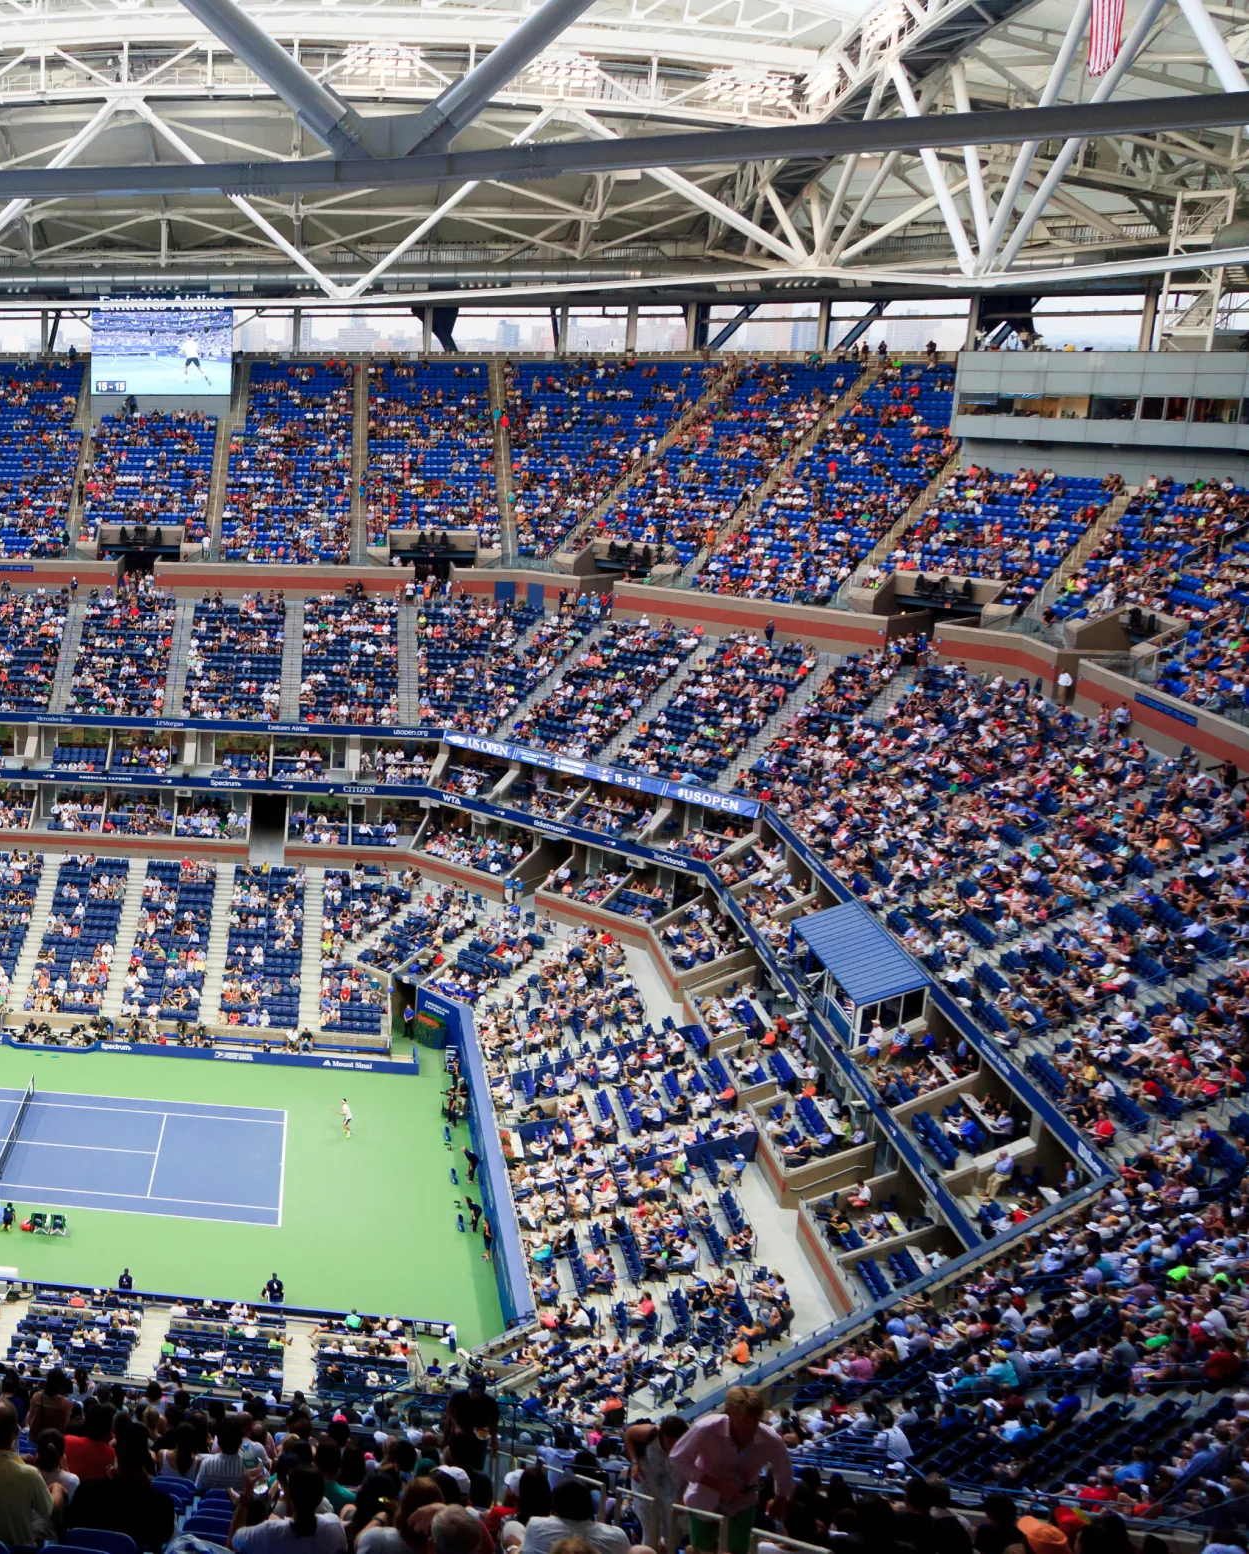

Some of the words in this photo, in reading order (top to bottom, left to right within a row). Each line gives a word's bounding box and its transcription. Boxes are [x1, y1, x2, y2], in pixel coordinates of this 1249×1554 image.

[97, 382, 107, 391] 15
[115, 382, 125, 391] 15
[36, 715, 72, 723] Mercedes-Benz
[393, 729, 429, 737] usopen.org
[467, 738, 480, 750] US
[481, 741, 509, 756] OPEN
[210, 780, 240, 788] Spectrum
[614, 773, 623, 783] 15
[628, 775, 636, 786] 15
[343, 785, 376, 794] CITIZEN
[442, 793, 461, 805] WTA
[677, 788, 739, 811] #USOPEN
[533, 819, 569, 834] ticketmaster
[663, 854, 688, 868] Orlando
[424, 1003, 445, 1016] EXPRESS
[425, 1000, 450, 1014] AMERICAN
[100, 1042, 130, 1051] Spectrum
[332, 1060, 354, 1068] Mount
